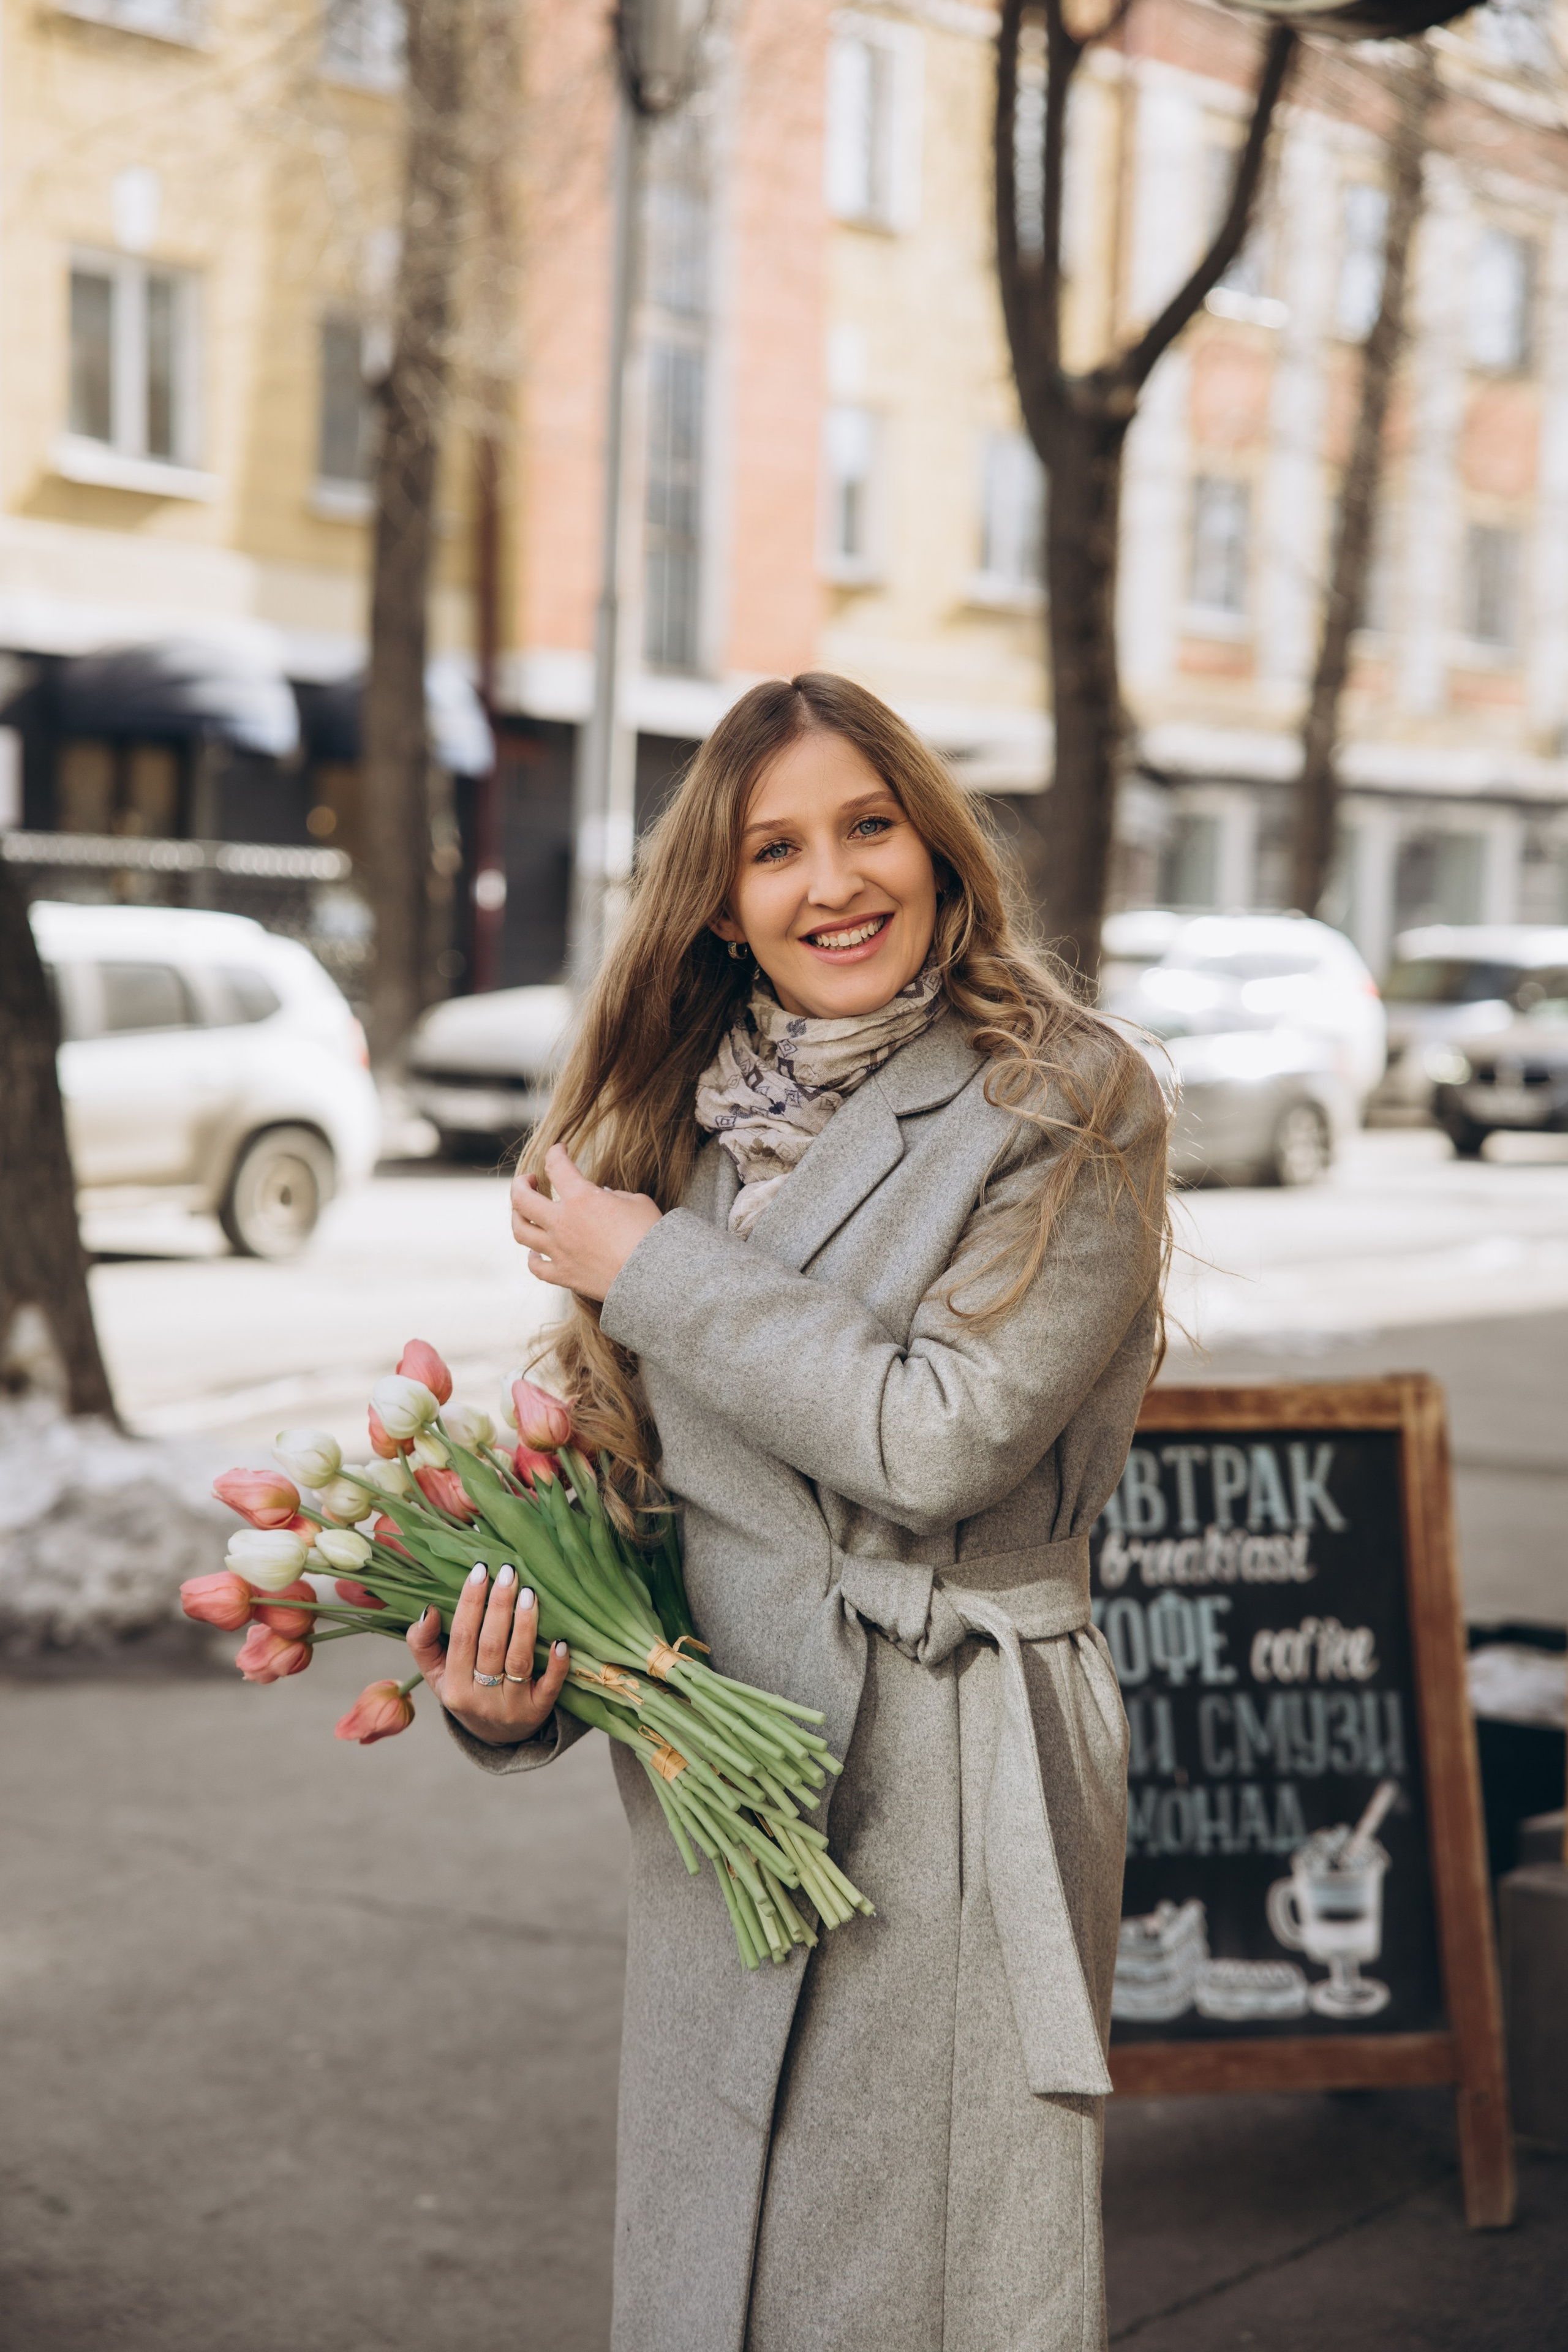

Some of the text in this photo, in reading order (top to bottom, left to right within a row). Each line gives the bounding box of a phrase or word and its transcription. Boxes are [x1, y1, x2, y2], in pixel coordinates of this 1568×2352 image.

[1098, 1524, 1318, 1588] breakfast
[1090, 1589, 1238, 1687] ОФЕ
[1249, 1615, 1380, 1684] coffee
[1197, 1688, 1408, 1777] СМУЗИ
